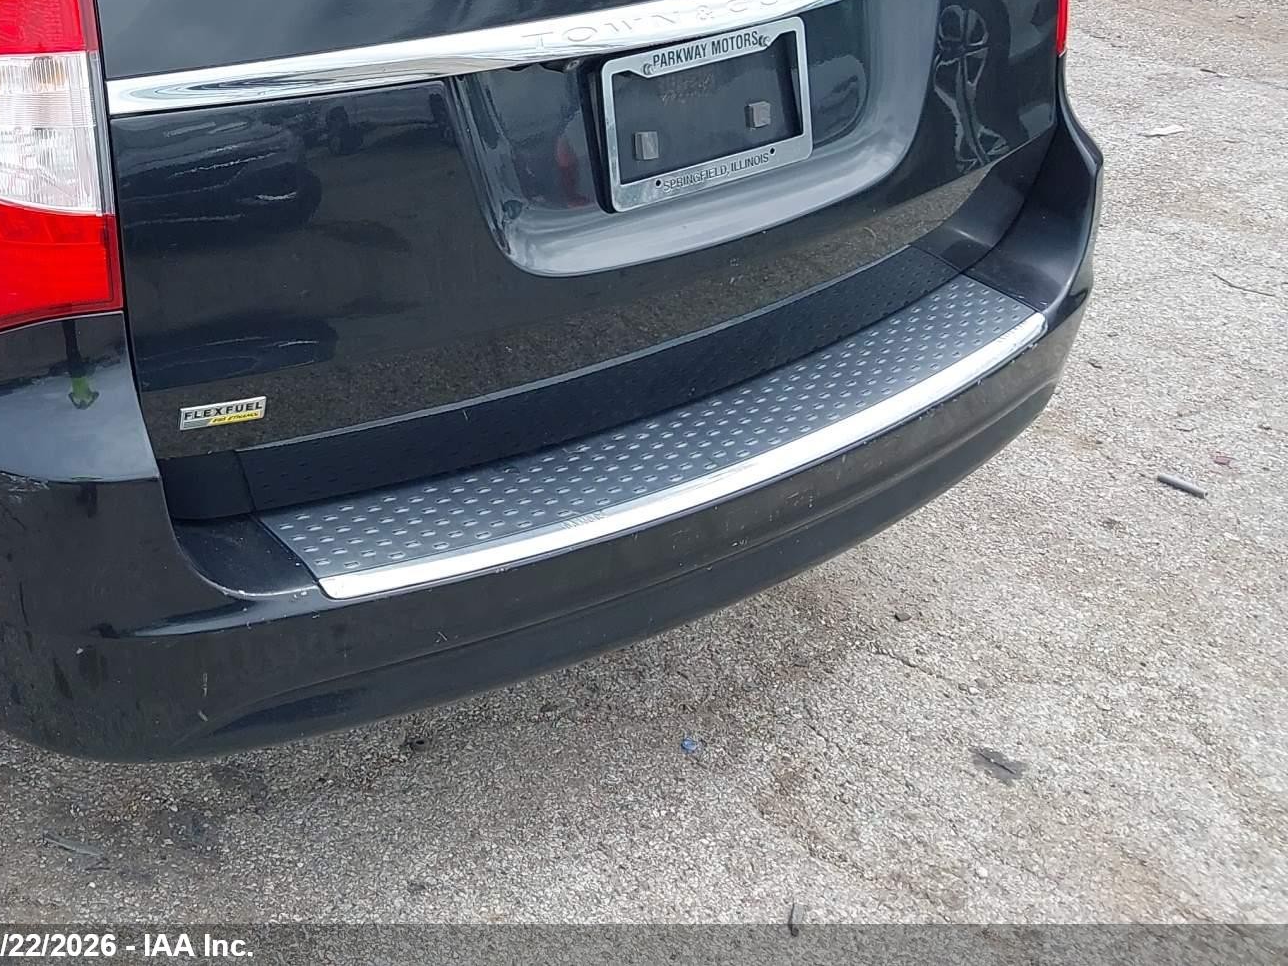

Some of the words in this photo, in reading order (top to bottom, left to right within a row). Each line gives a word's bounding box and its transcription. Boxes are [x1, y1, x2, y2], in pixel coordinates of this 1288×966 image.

[695, 4, 716, 21] &
[652, 42, 708, 68] PARKWAY
[711, 30, 759, 56] MOTORS
[663, 165, 731, 193] SPRINGFIELD,
[731, 152, 770, 173] ILLINOIS
